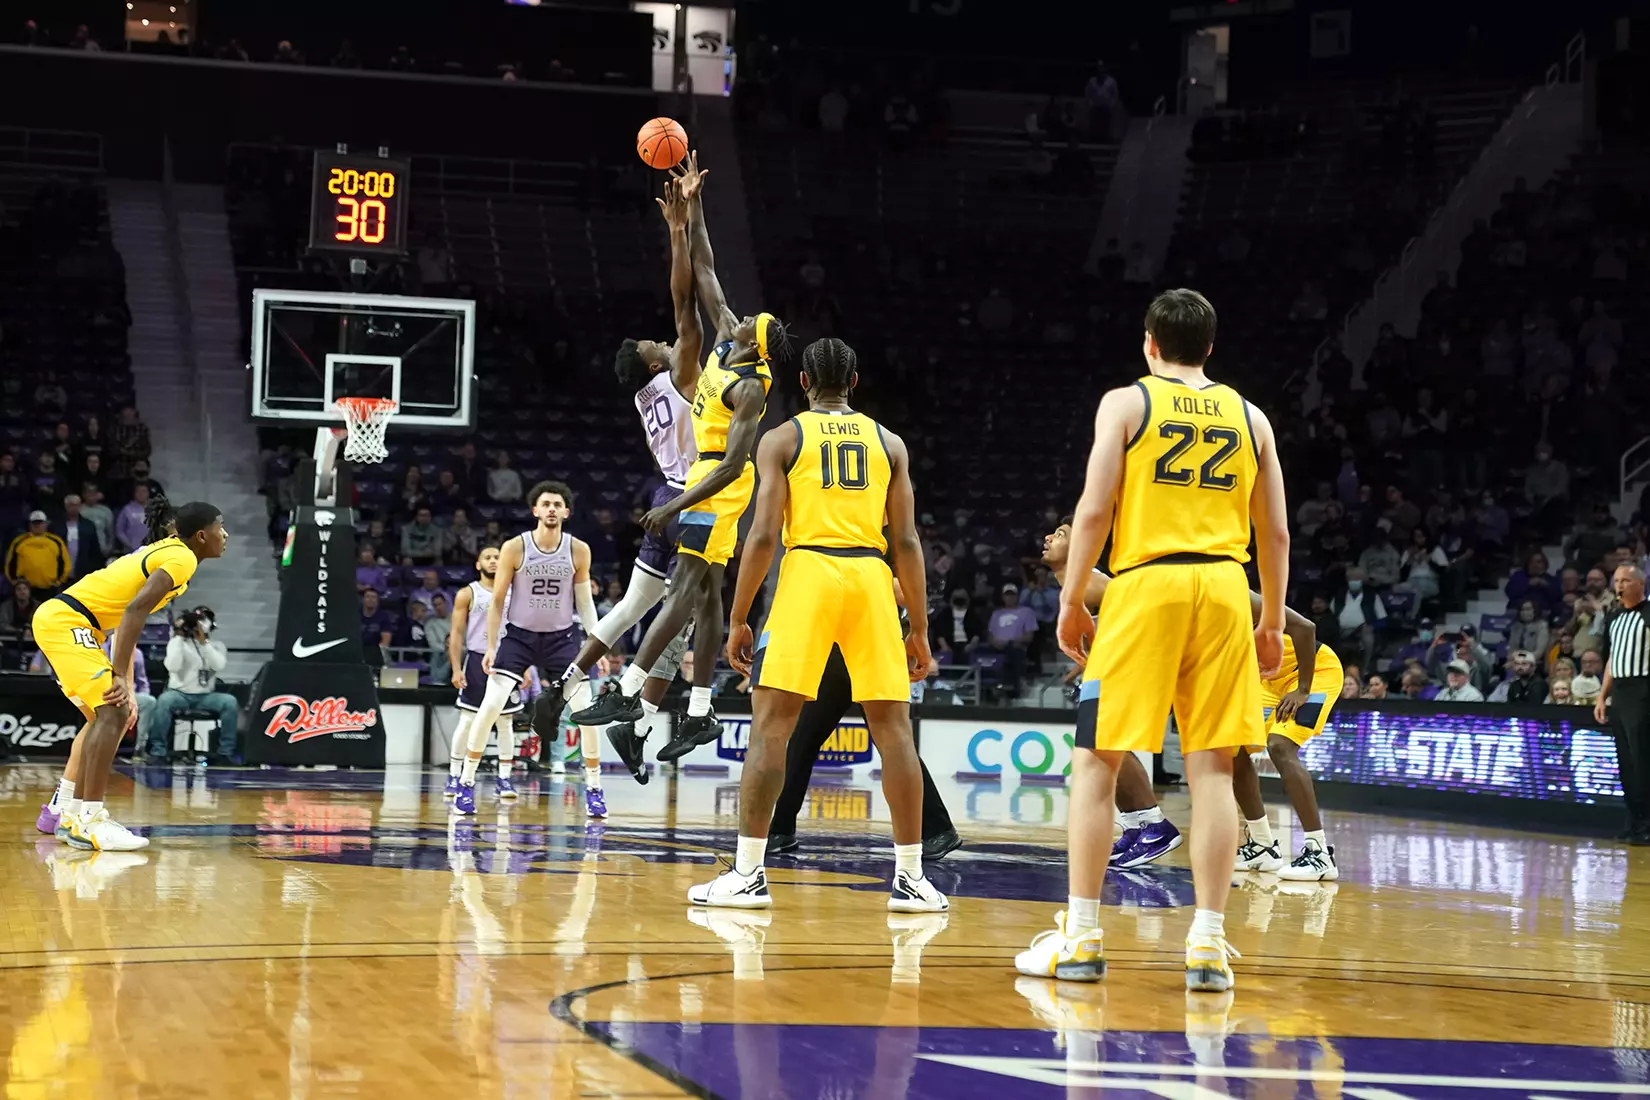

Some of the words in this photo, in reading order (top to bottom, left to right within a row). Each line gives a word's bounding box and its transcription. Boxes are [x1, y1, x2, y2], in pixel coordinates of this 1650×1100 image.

[328, 168, 395, 198] 20:00
[335, 197, 386, 243] 30
[645, 395, 674, 438] 20
[1173, 395, 1223, 418] KOLEK
[820, 422, 860, 435] LEWIS
[820, 440, 869, 490] 10
[1152, 420, 1242, 492] 22
[317, 530, 331, 633] WILDCATS
[525, 565, 570, 577] KANSAS
[531, 578, 561, 596] 25
[528, 598, 561, 610] STATE
[260, 694, 377, 738] Dillons
[1368, 729, 1524, 786] K-STATE
